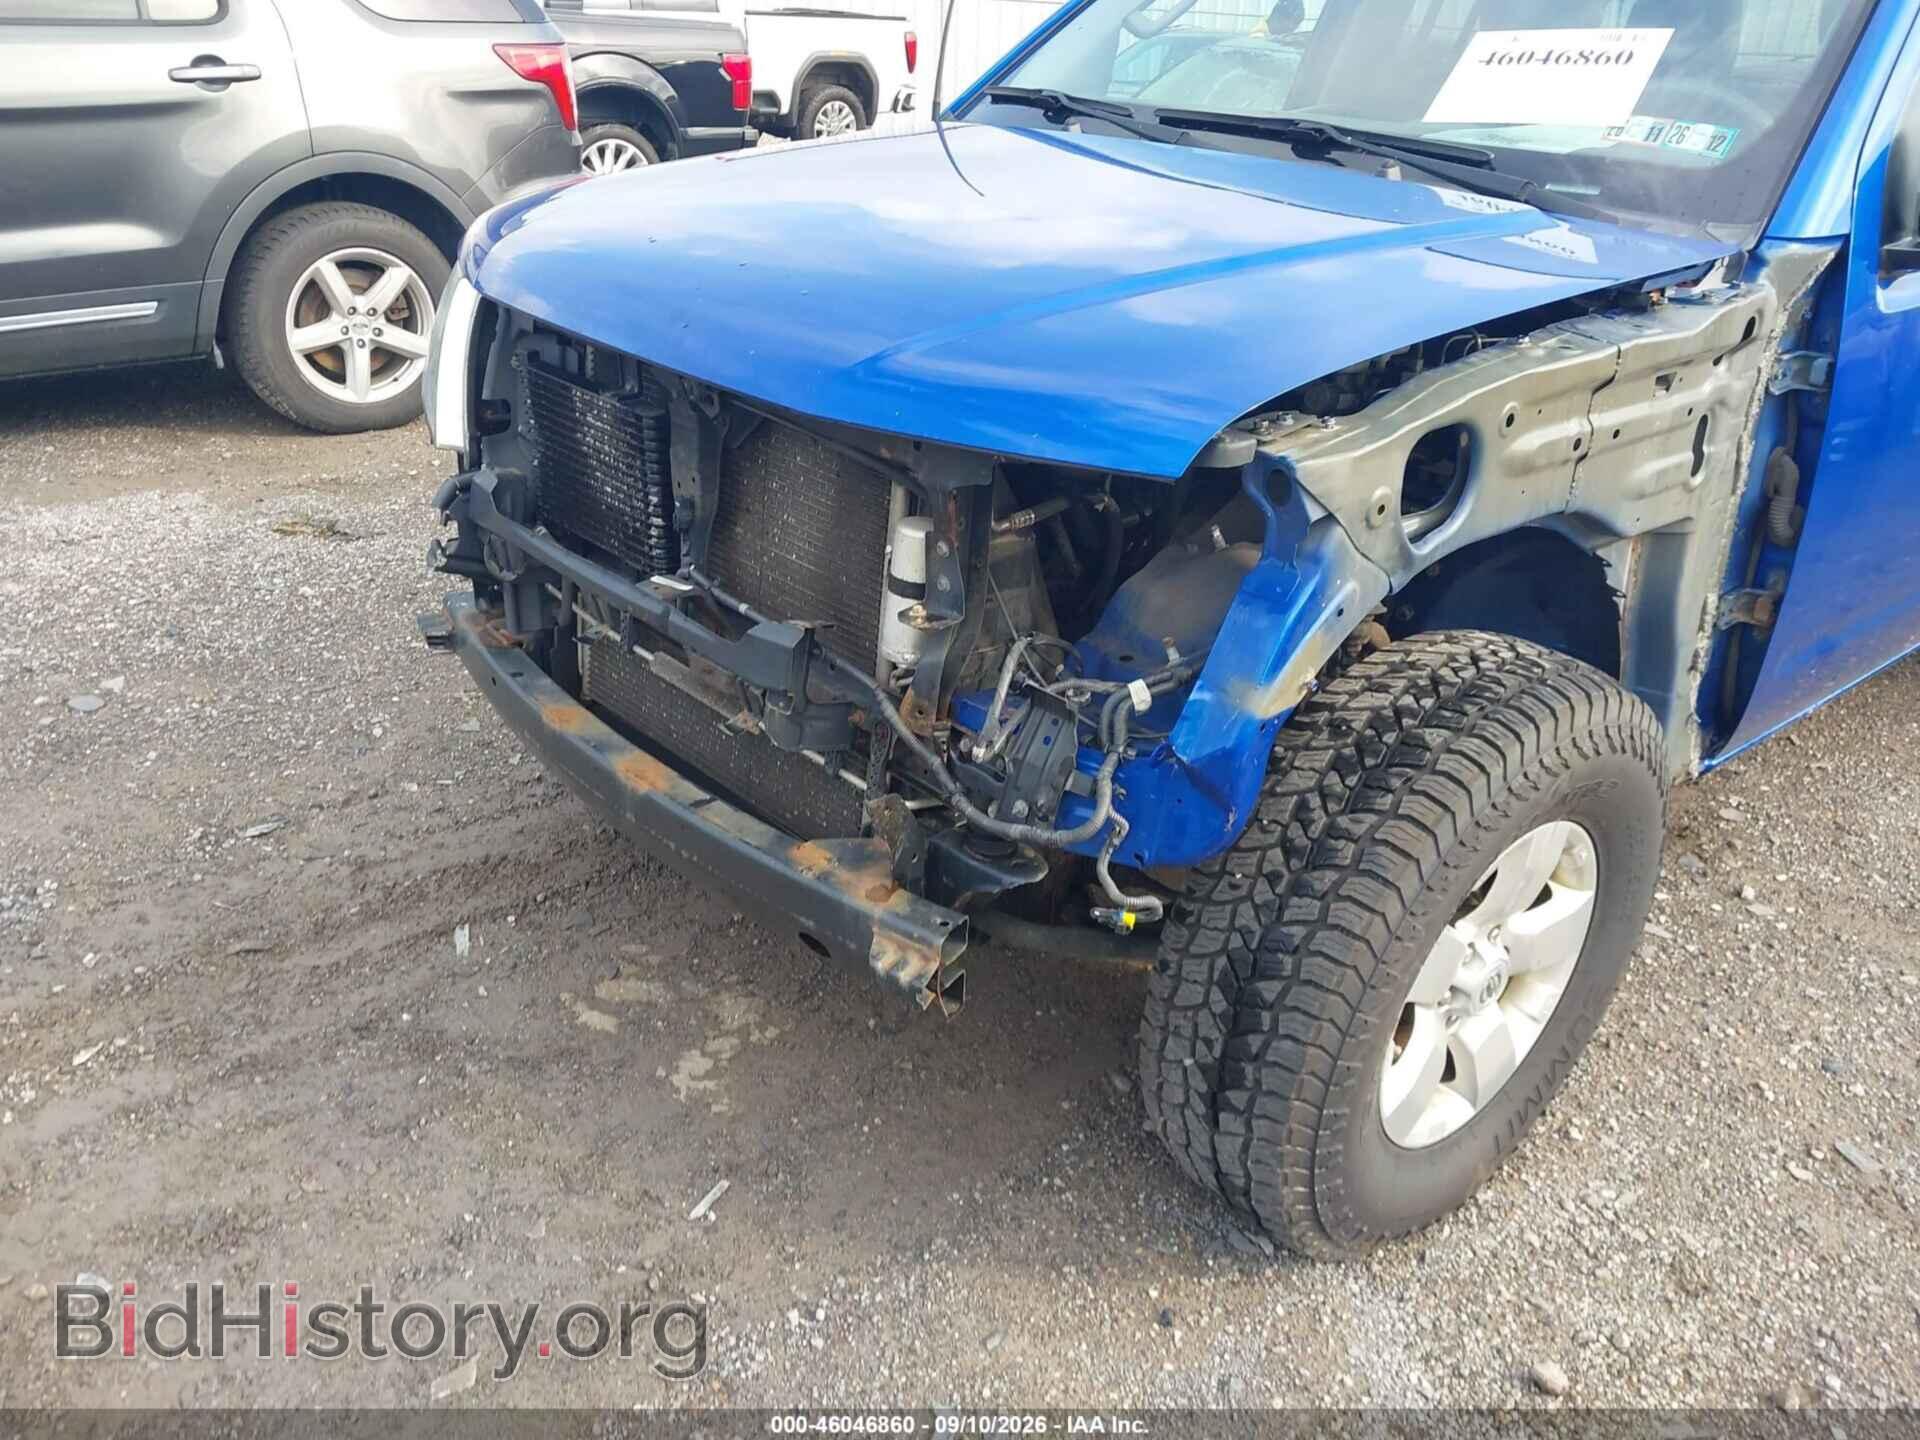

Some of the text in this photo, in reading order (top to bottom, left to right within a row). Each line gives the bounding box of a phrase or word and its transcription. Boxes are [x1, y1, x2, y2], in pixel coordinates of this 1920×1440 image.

[1478, 47, 1635, 67] 46046860
[1668, 126, 1727, 152] 26 12
